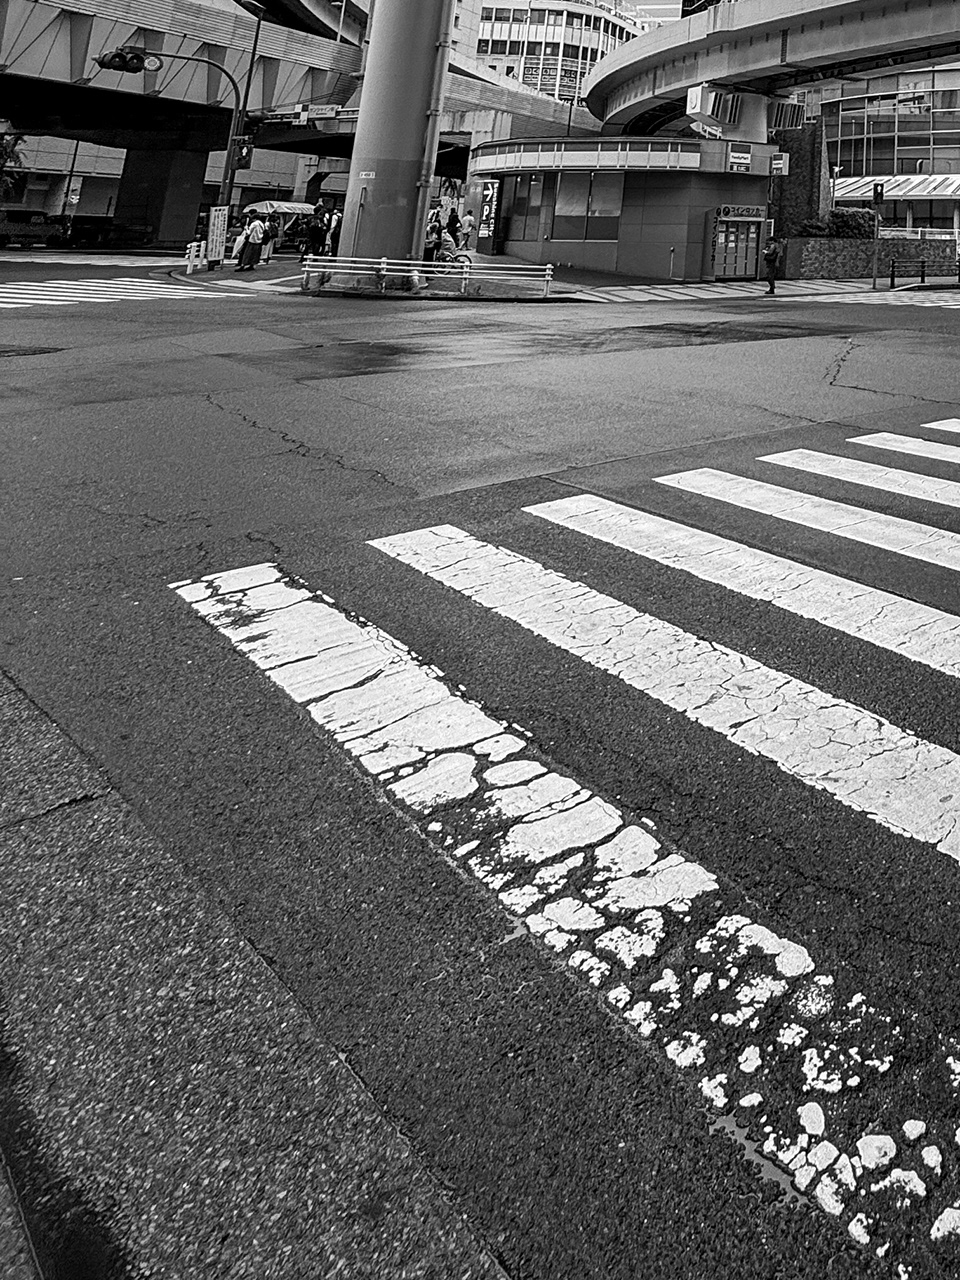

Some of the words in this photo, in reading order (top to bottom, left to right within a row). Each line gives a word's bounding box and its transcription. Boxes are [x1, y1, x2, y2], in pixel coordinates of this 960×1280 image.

[482, 205, 490, 220] P
[730, 206, 764, 215] コインロッカー
